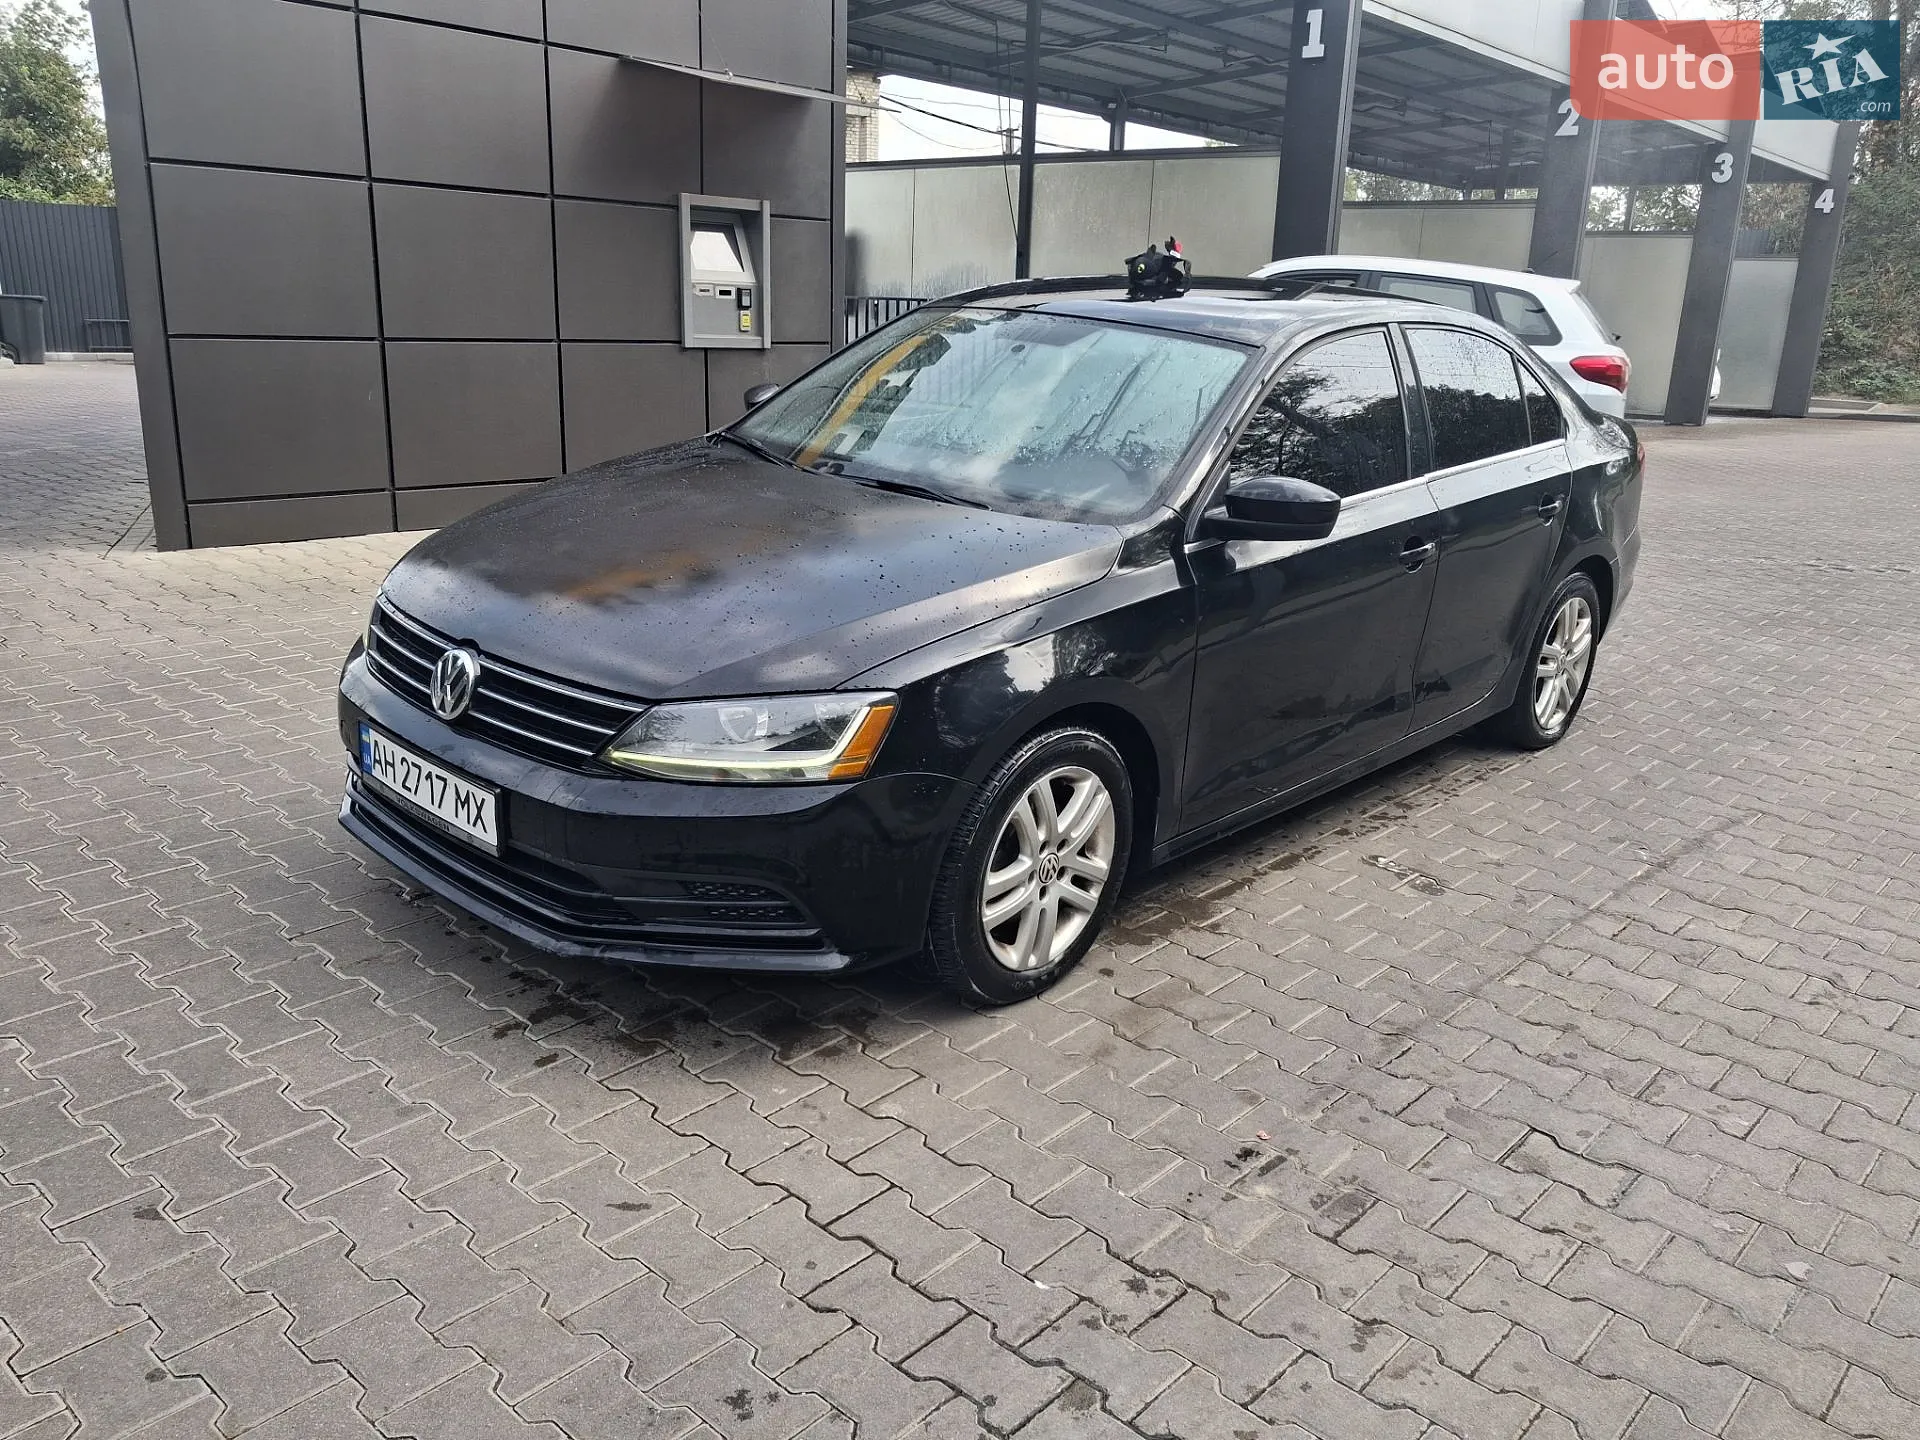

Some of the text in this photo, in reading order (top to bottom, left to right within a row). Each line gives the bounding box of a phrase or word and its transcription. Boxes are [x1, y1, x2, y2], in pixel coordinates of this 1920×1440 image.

[1302, 9, 1325, 59] 1
[1555, 99, 1580, 136] 2
[1711, 153, 1734, 183] 3
[1814, 188, 1835, 213] 4
[363, 754, 372, 768] UA
[373, 740, 396, 784] AH
[400, 757, 448, 809] 2717
[454, 783, 488, 833] MX
